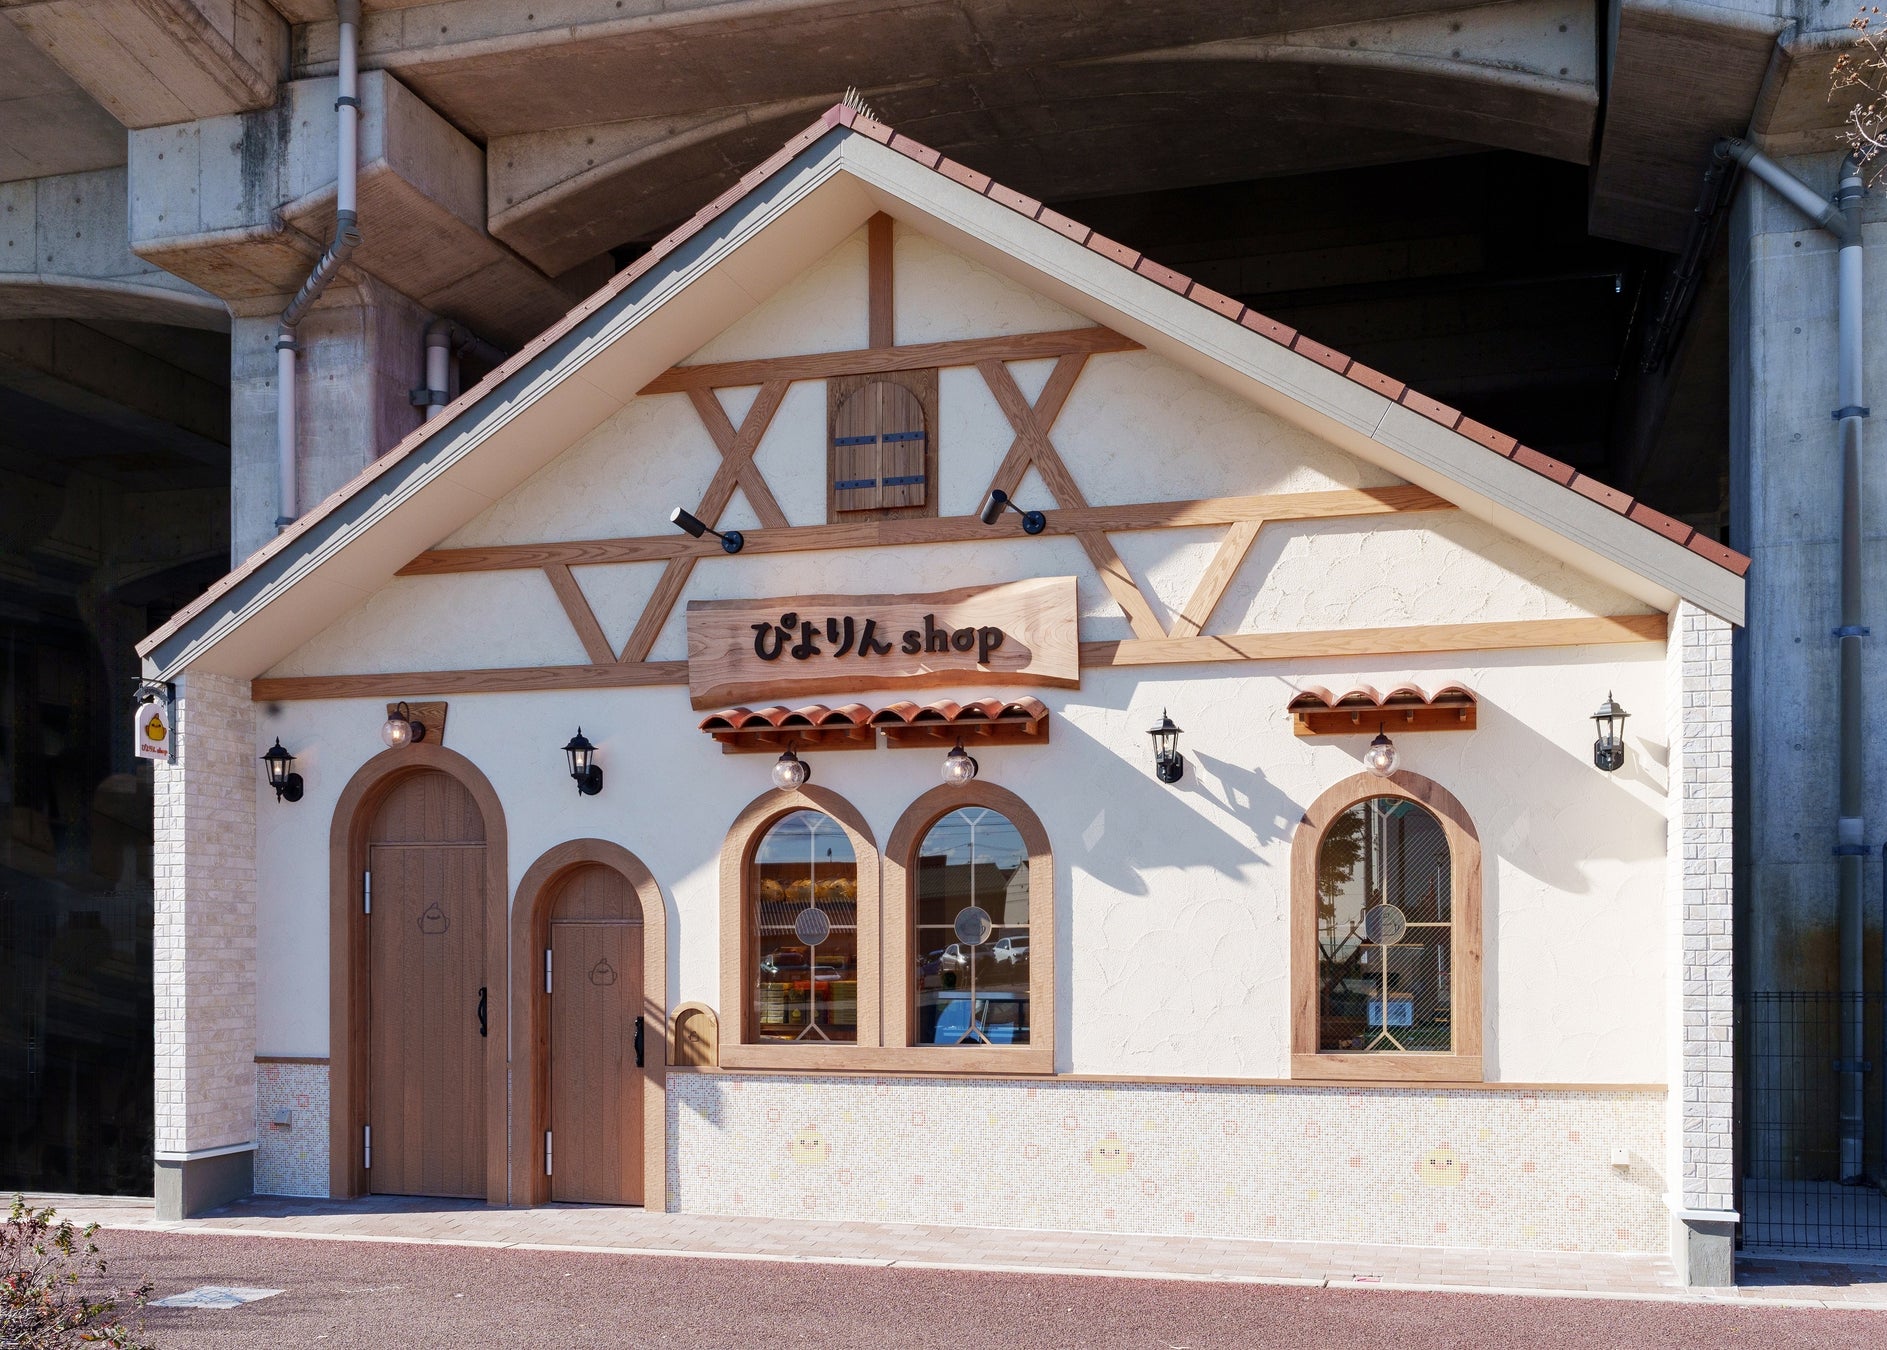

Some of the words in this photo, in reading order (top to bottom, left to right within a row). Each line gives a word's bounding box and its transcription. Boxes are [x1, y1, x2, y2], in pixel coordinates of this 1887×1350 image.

[751, 612, 892, 661] ぴよりん
[902, 614, 1003, 664] shop
